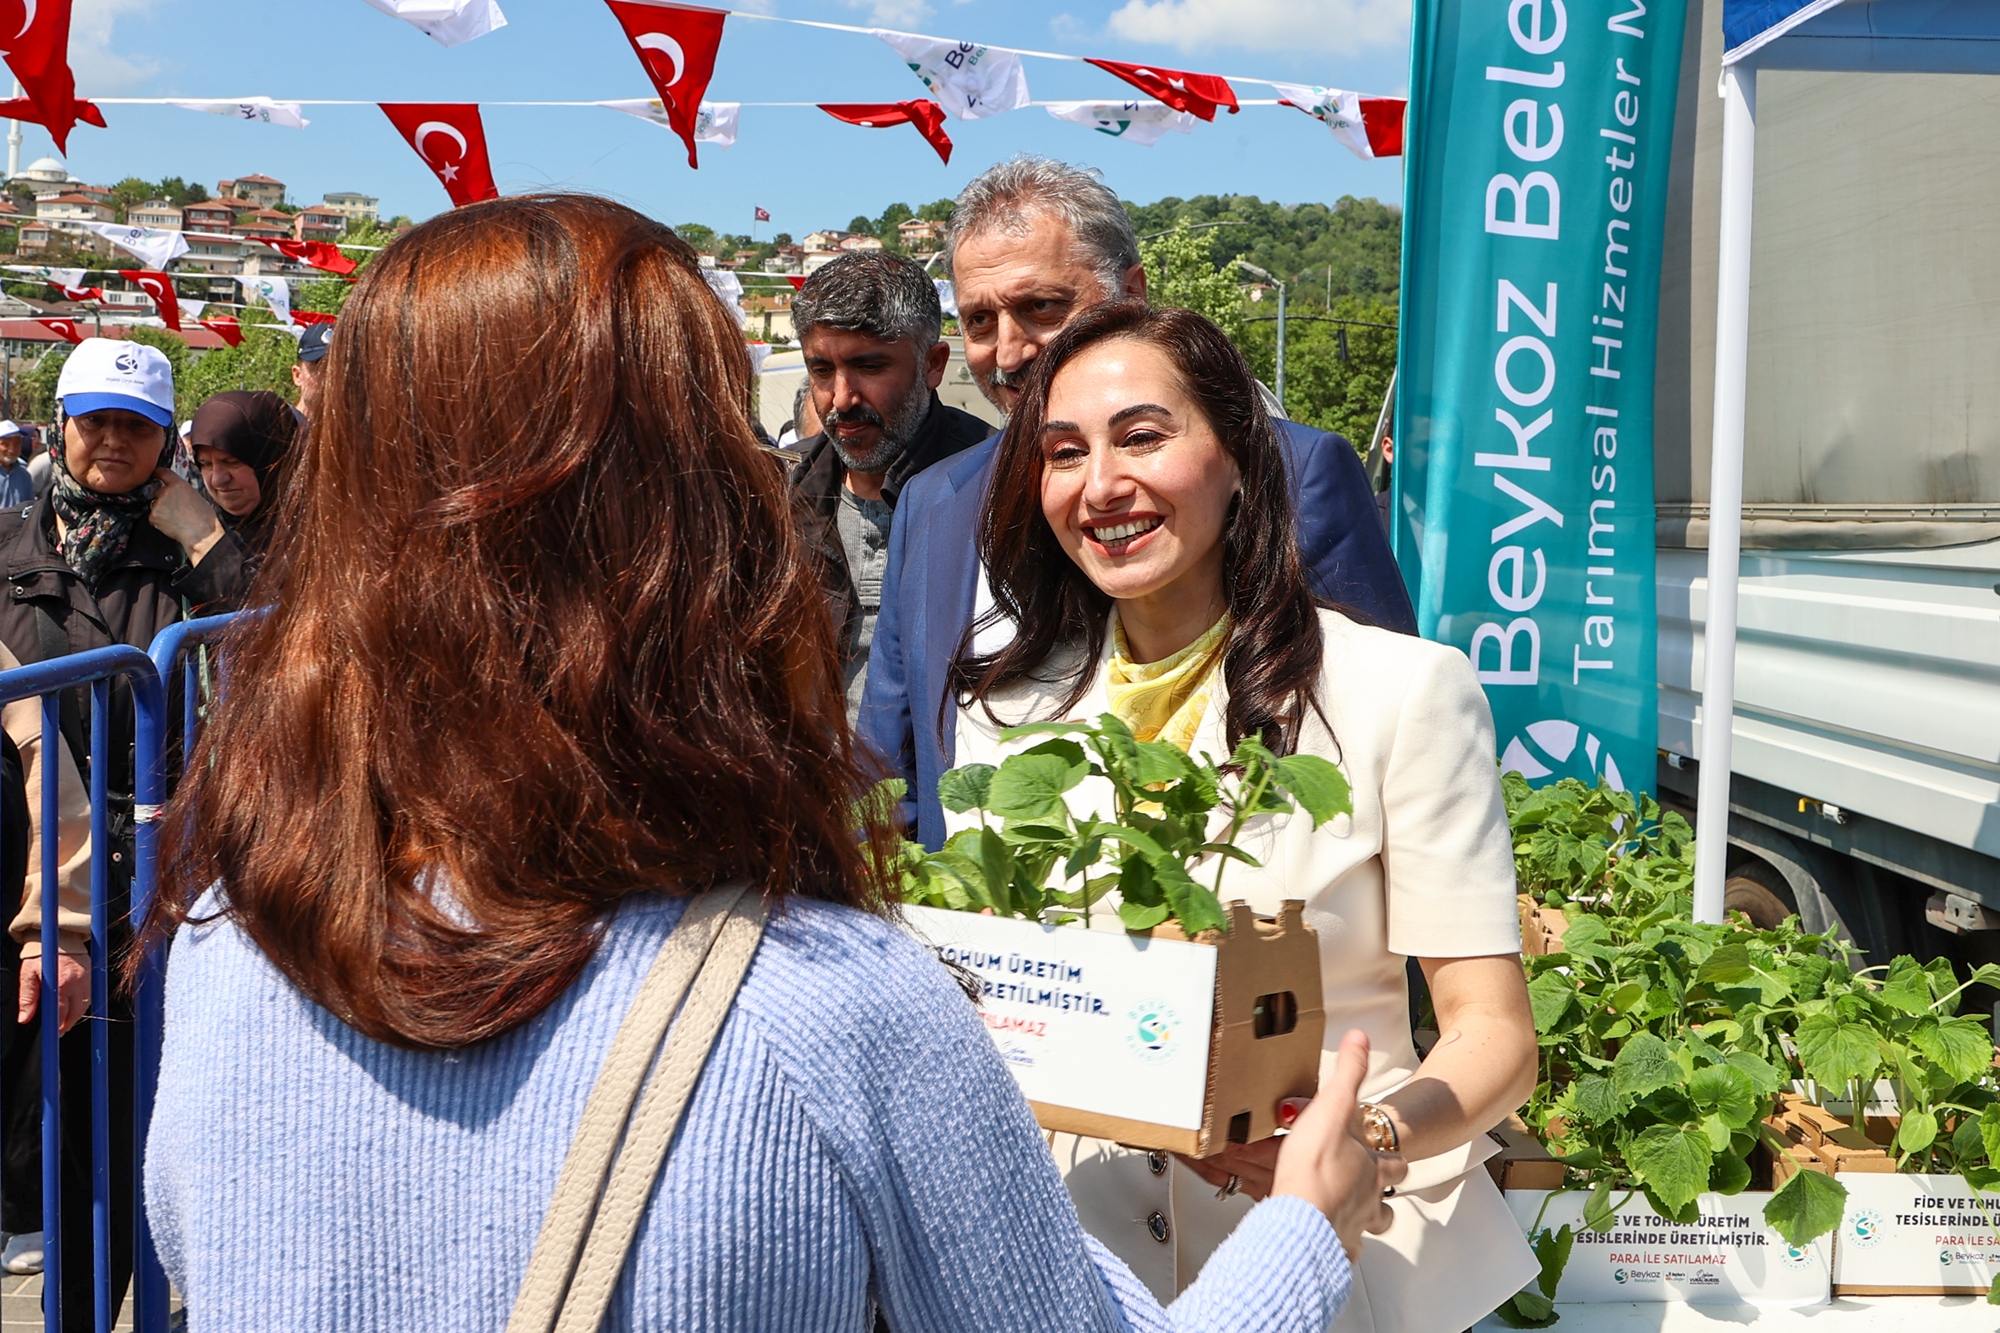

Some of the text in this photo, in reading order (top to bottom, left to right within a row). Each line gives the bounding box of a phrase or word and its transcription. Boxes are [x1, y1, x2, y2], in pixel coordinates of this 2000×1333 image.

[1590, 57, 1640, 379] Hizmetler
[1474, 0, 1568, 686] Beykoz Bele
[1573, 405, 1618, 685] Tarımsal
[1008, 953, 1083, 983] ÜRETİM
[980, 981, 1111, 1015] RETİLMİŞTİR.
[1914, 1195, 1945, 1209] FİDE
[1948, 1198, 1965, 1209] VE
[1623, 1215, 1642, 1227] VE
[1644, 1215, 1694, 1228] TOH
[1698, 1213, 1750, 1228] ÜRETİM
[1849, 1209, 1884, 1224] Beykoz
[1896, 1213, 1989, 1227] TESİSLERİNDE
[1670, 1231, 1770, 1248] ÜRETİLMİŞTİR.
[1935, 1235, 1965, 1246] PARA
[1967, 1234, 1985, 1246] İLE
[1609, 1252, 1727, 1265] PARA İLE SATILAMAZ
[1955, 1252, 1985, 1262] Beykoz
[1630, 1270, 1661, 1280] Beykoz
